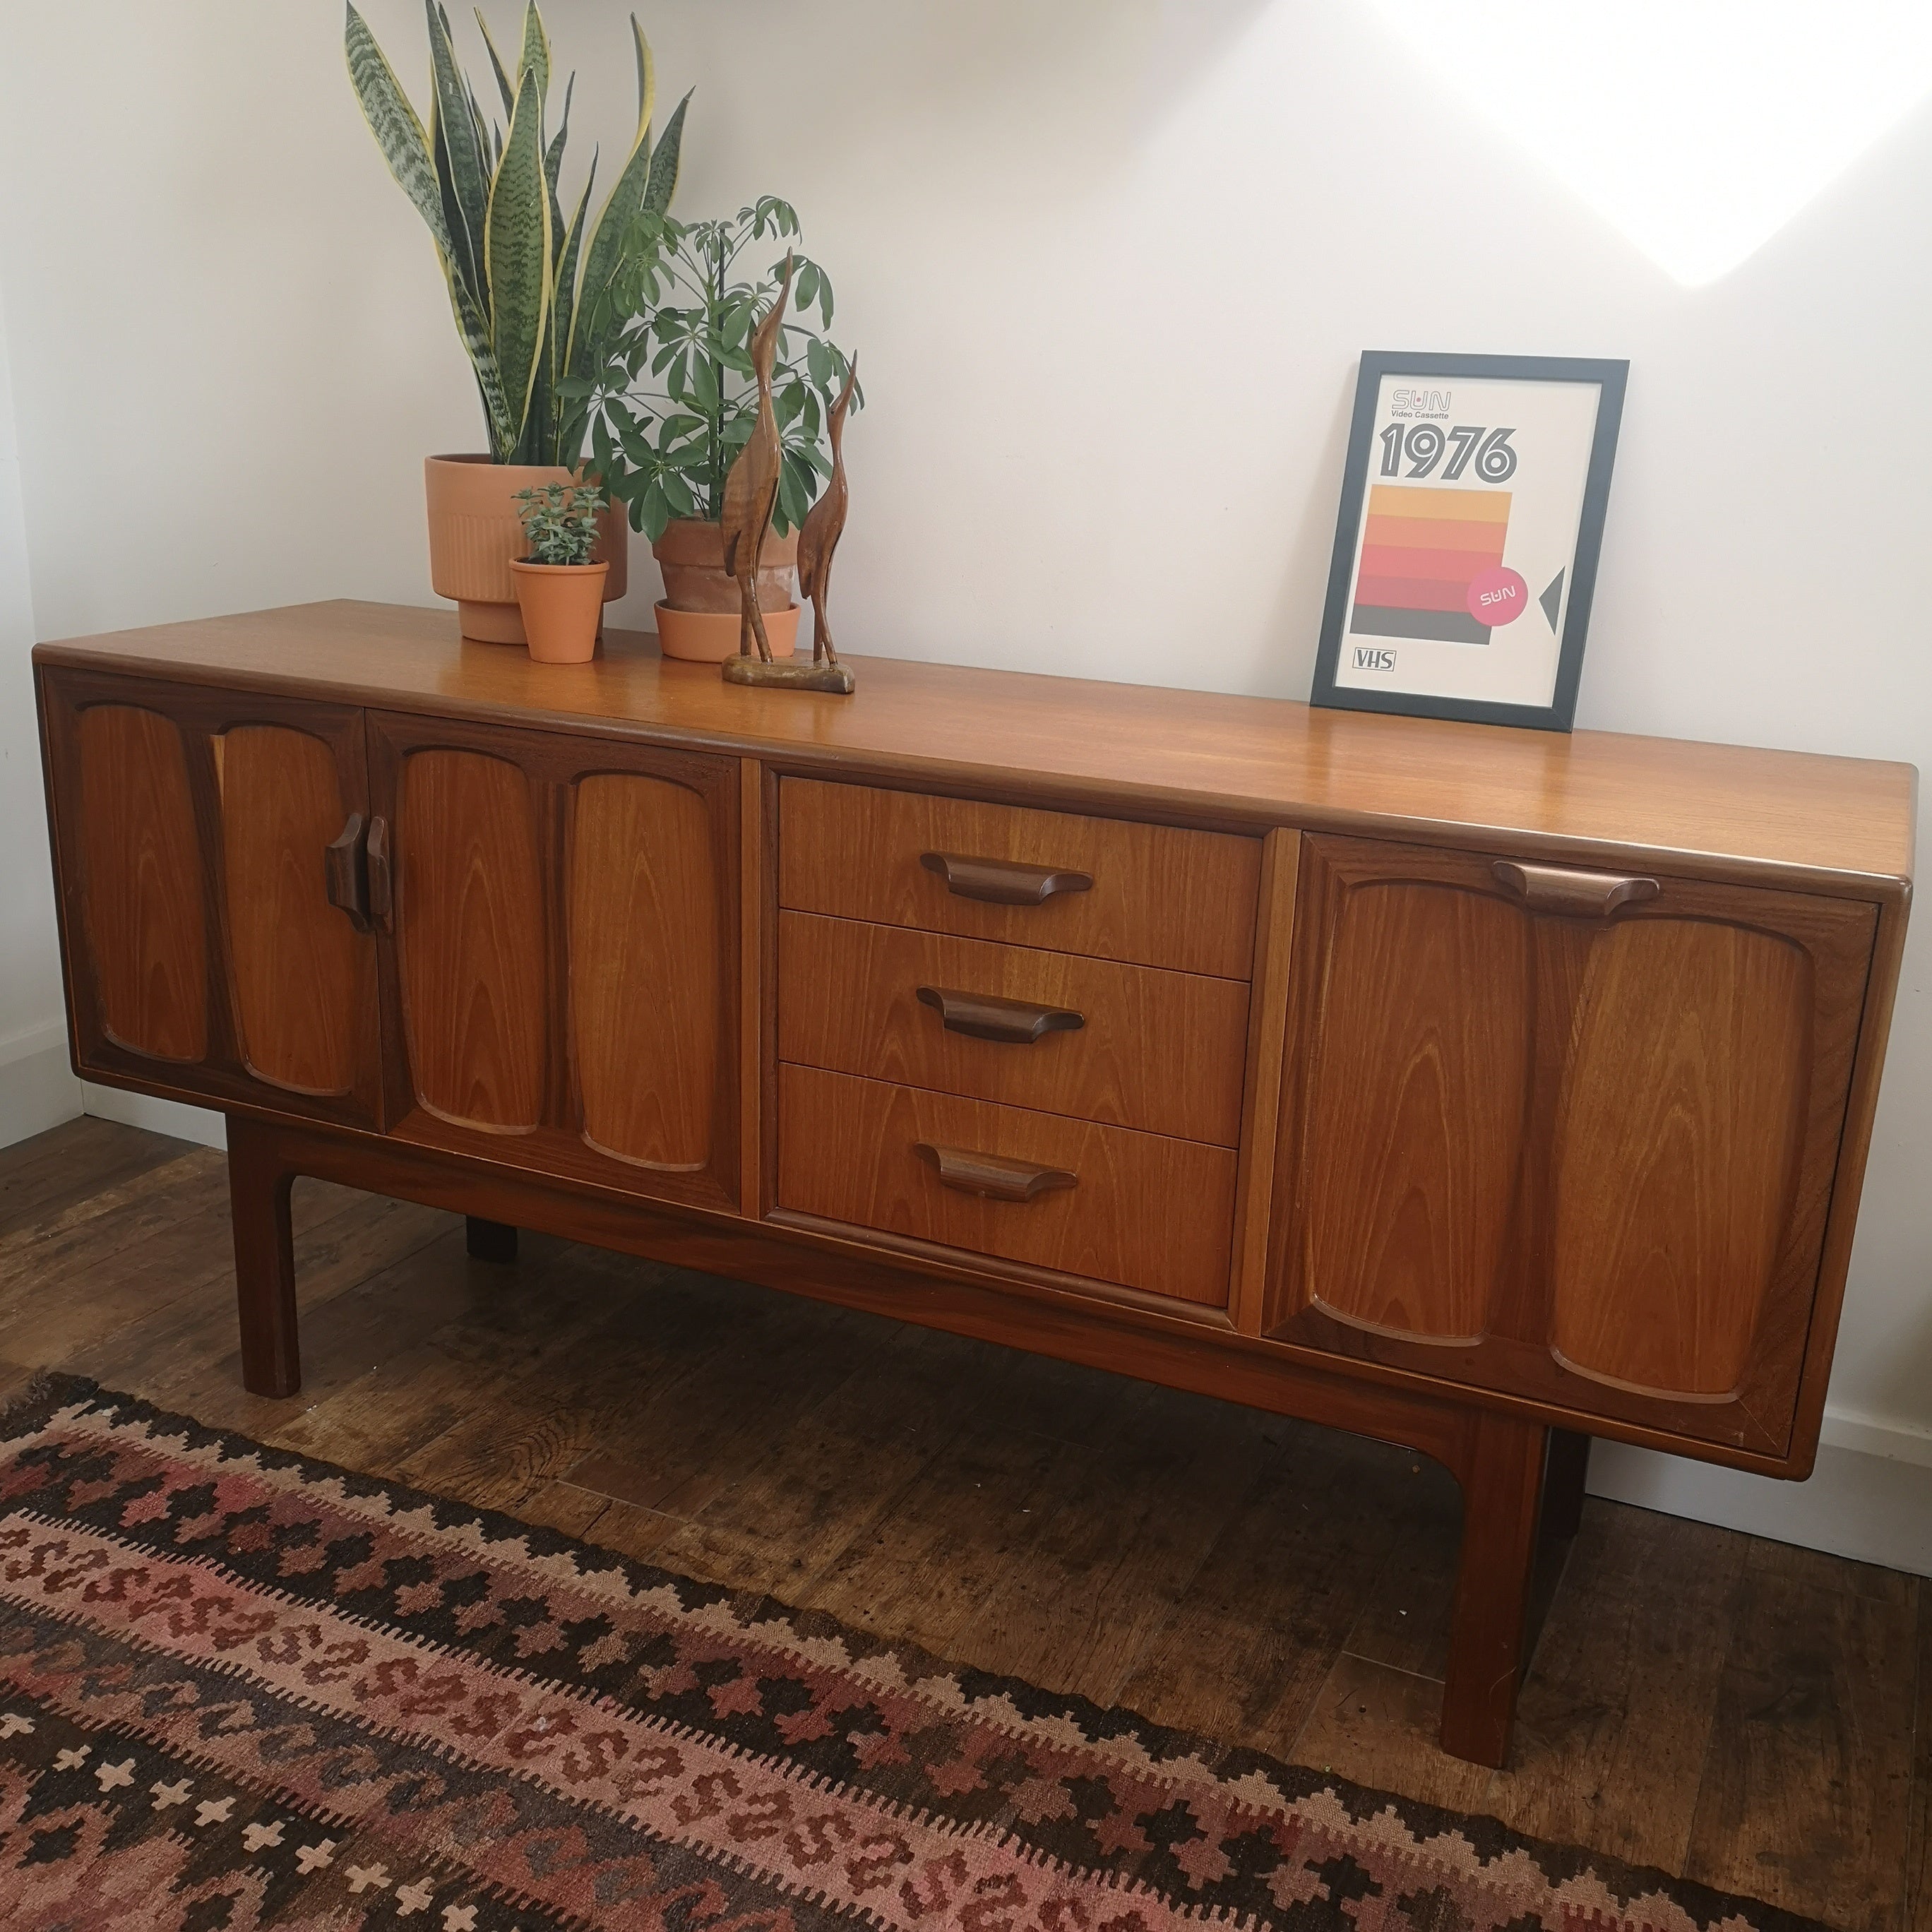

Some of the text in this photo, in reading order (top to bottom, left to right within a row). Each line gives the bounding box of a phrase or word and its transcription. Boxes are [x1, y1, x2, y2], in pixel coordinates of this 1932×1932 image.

[1391, 389, 1451, 412] SUN
[1415, 411, 1449, 419] Cassette
[1379, 423, 1517, 484] 1976
[1480, 585, 1516, 606] SUN
[1357, 649, 1393, 669] VHS
